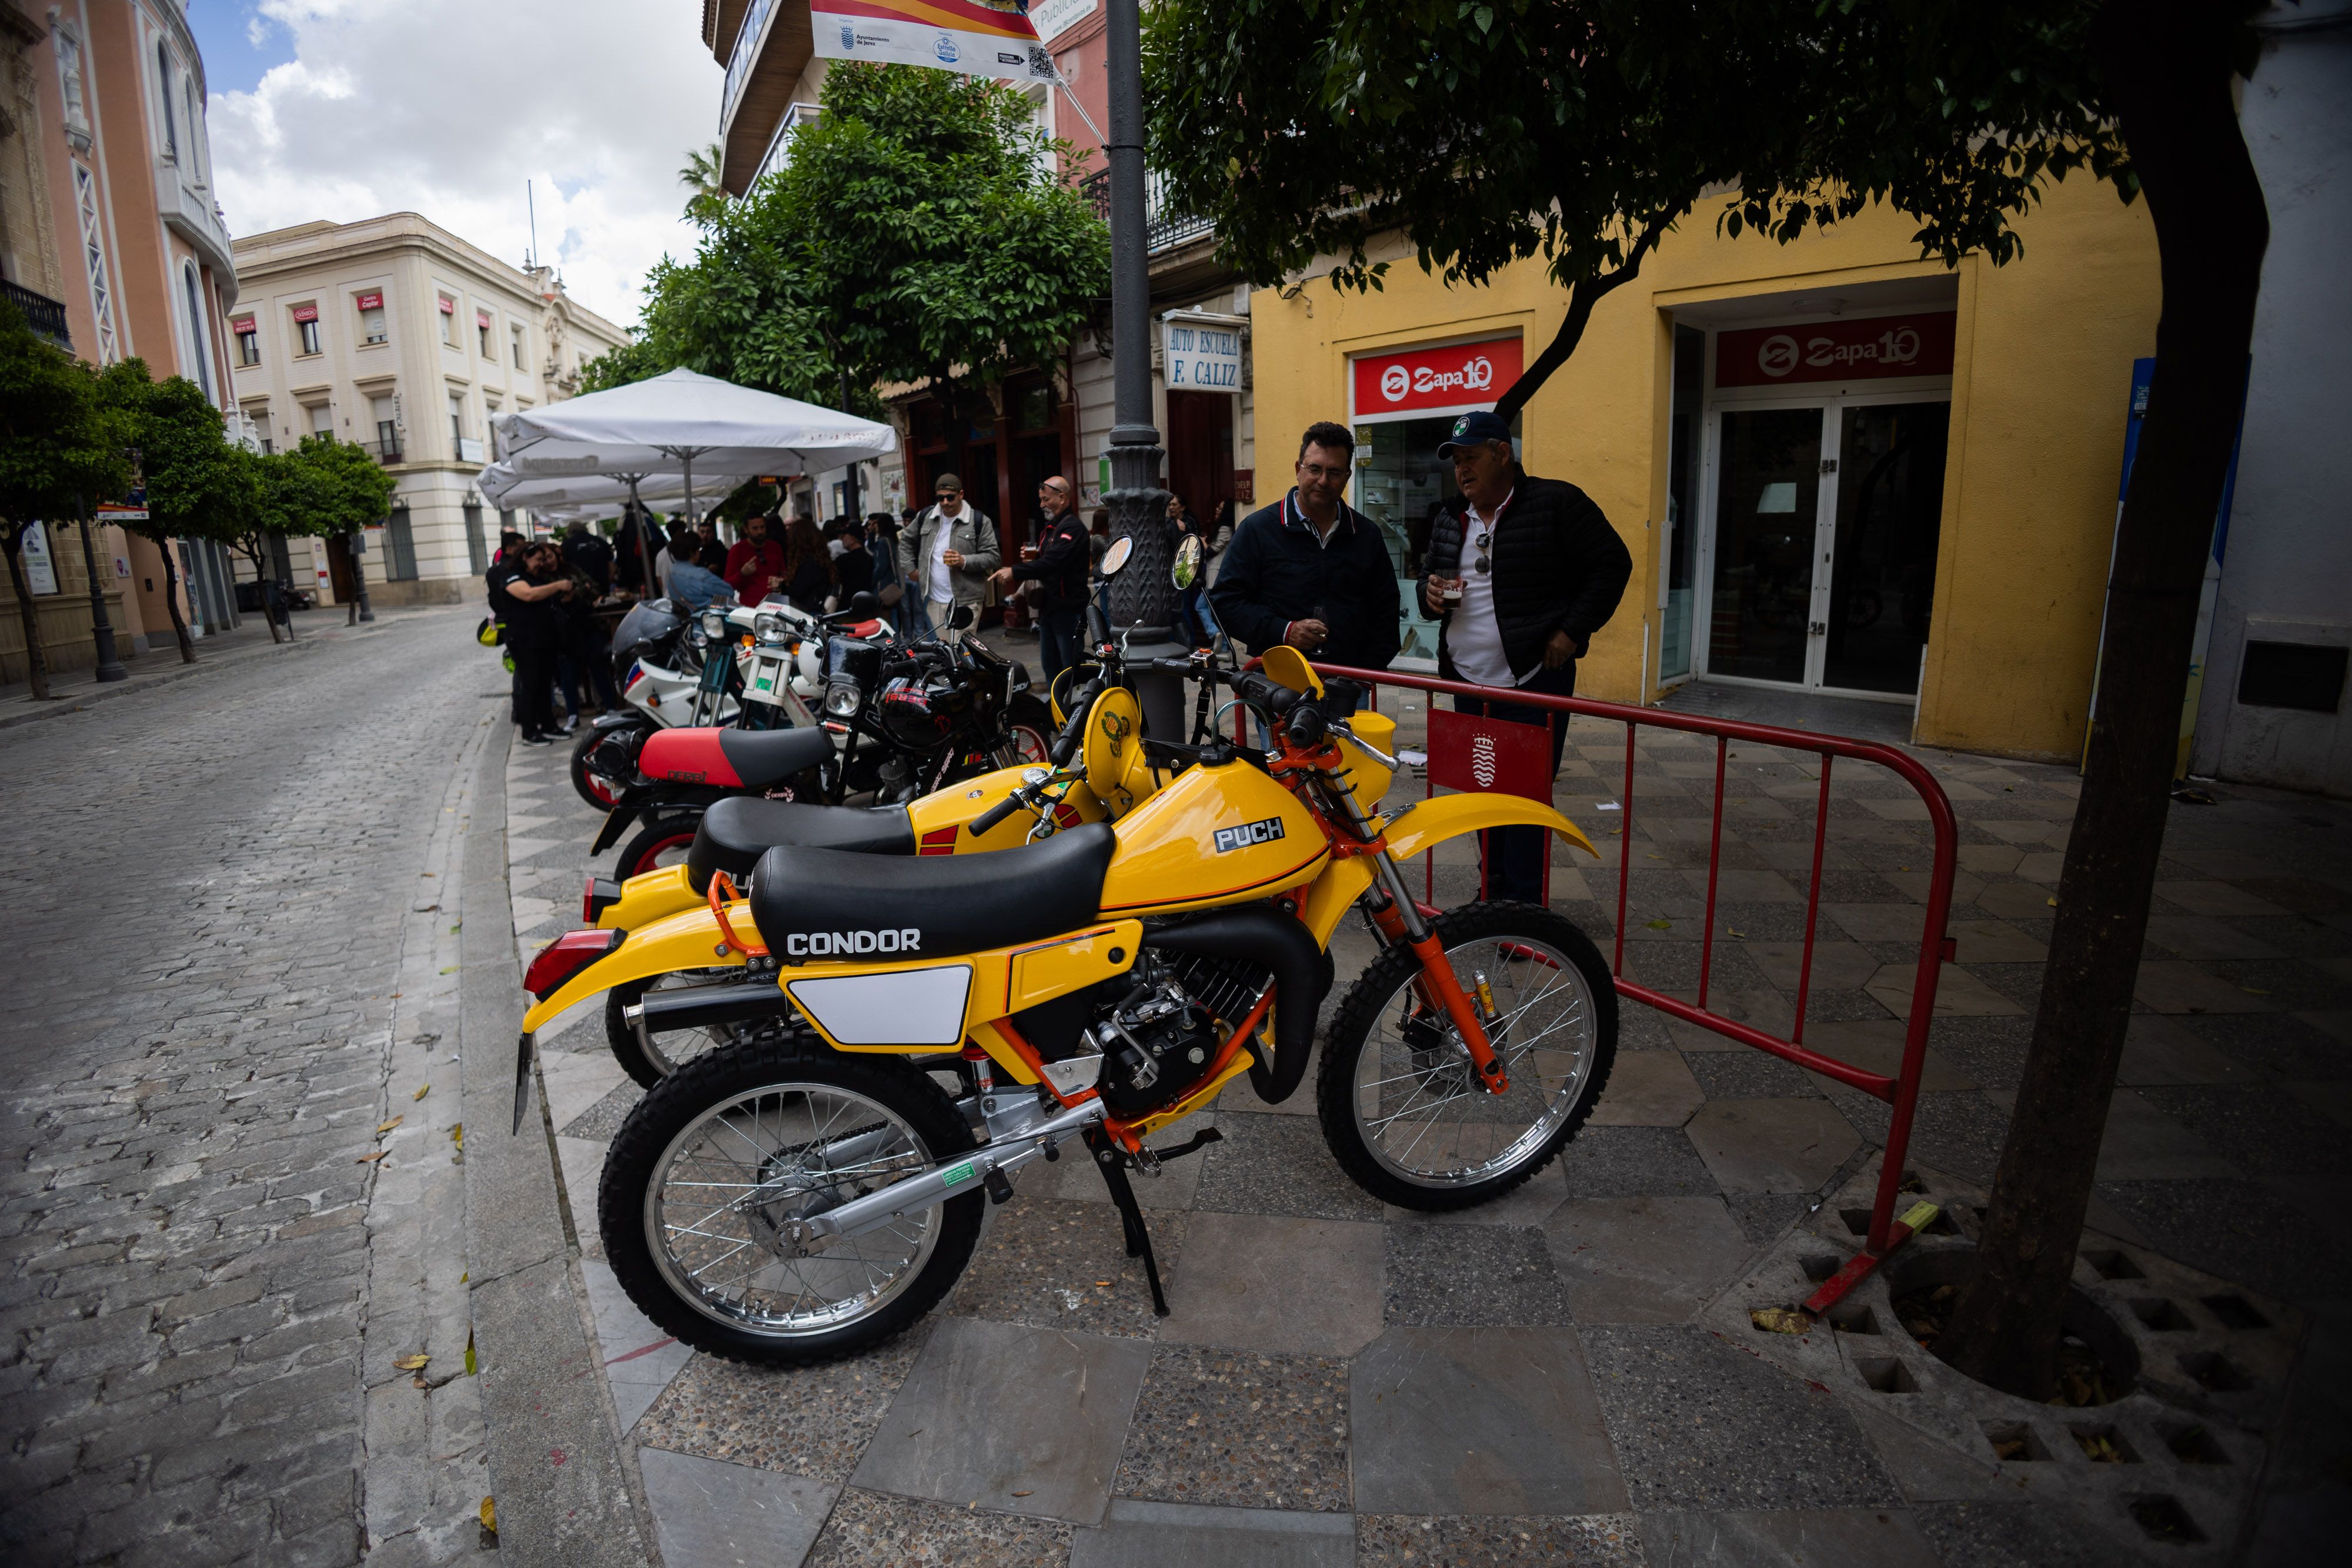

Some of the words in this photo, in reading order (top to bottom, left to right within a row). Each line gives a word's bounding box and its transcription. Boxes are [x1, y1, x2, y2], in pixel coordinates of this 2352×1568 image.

[856, 34, 890, 42] Ayuntamiento
[937, 43, 956, 52] Estrella
[938, 49, 956, 58] Galicia
[362, 300, 379, 308] Capilar
[1170, 328, 1194, 352] AUTO
[1200, 331, 1238, 356] ESCUELA
[1805, 326, 1920, 367] Zapa10
[1173, 360, 1184, 383] F.
[1195, 361, 1237, 386] CALIZ
[1413, 356, 1493, 393] Zapa10
[1217, 818, 1284, 850] PUCH
[787, 928, 921, 955] CONDOR
